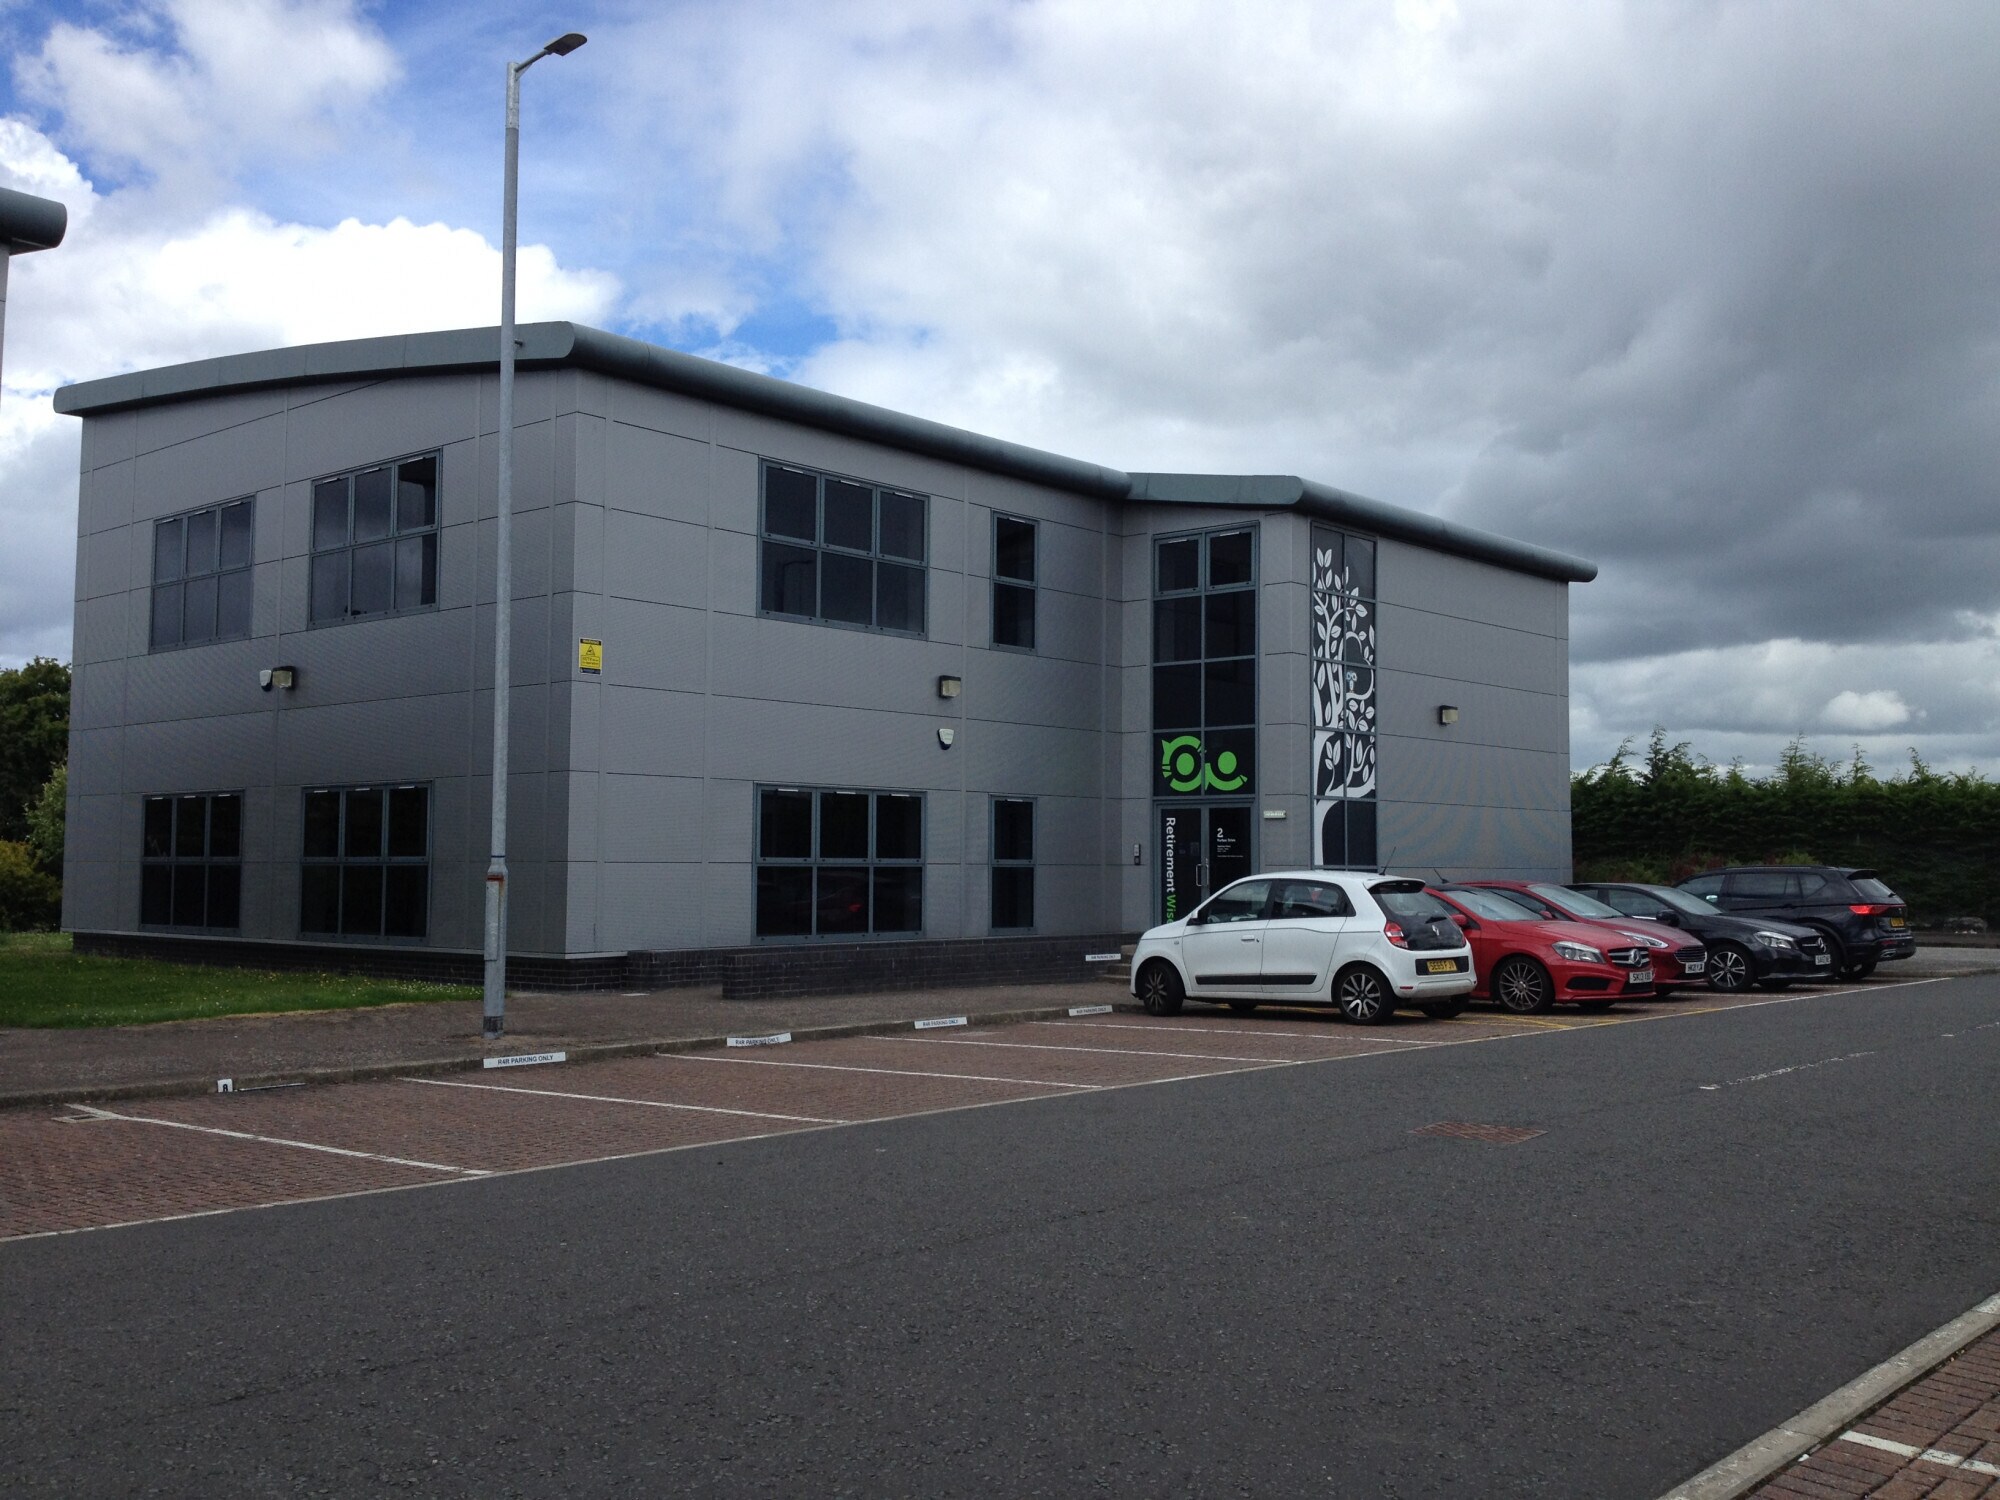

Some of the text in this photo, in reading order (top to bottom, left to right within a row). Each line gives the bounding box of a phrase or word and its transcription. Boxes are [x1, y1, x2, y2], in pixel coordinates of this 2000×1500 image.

[1217, 827, 1224, 838] 2
[1166, 818, 1176, 892] Retirement
[510, 1056, 537, 1064] PARKING
[538, 1054, 554, 1062] ONLY
